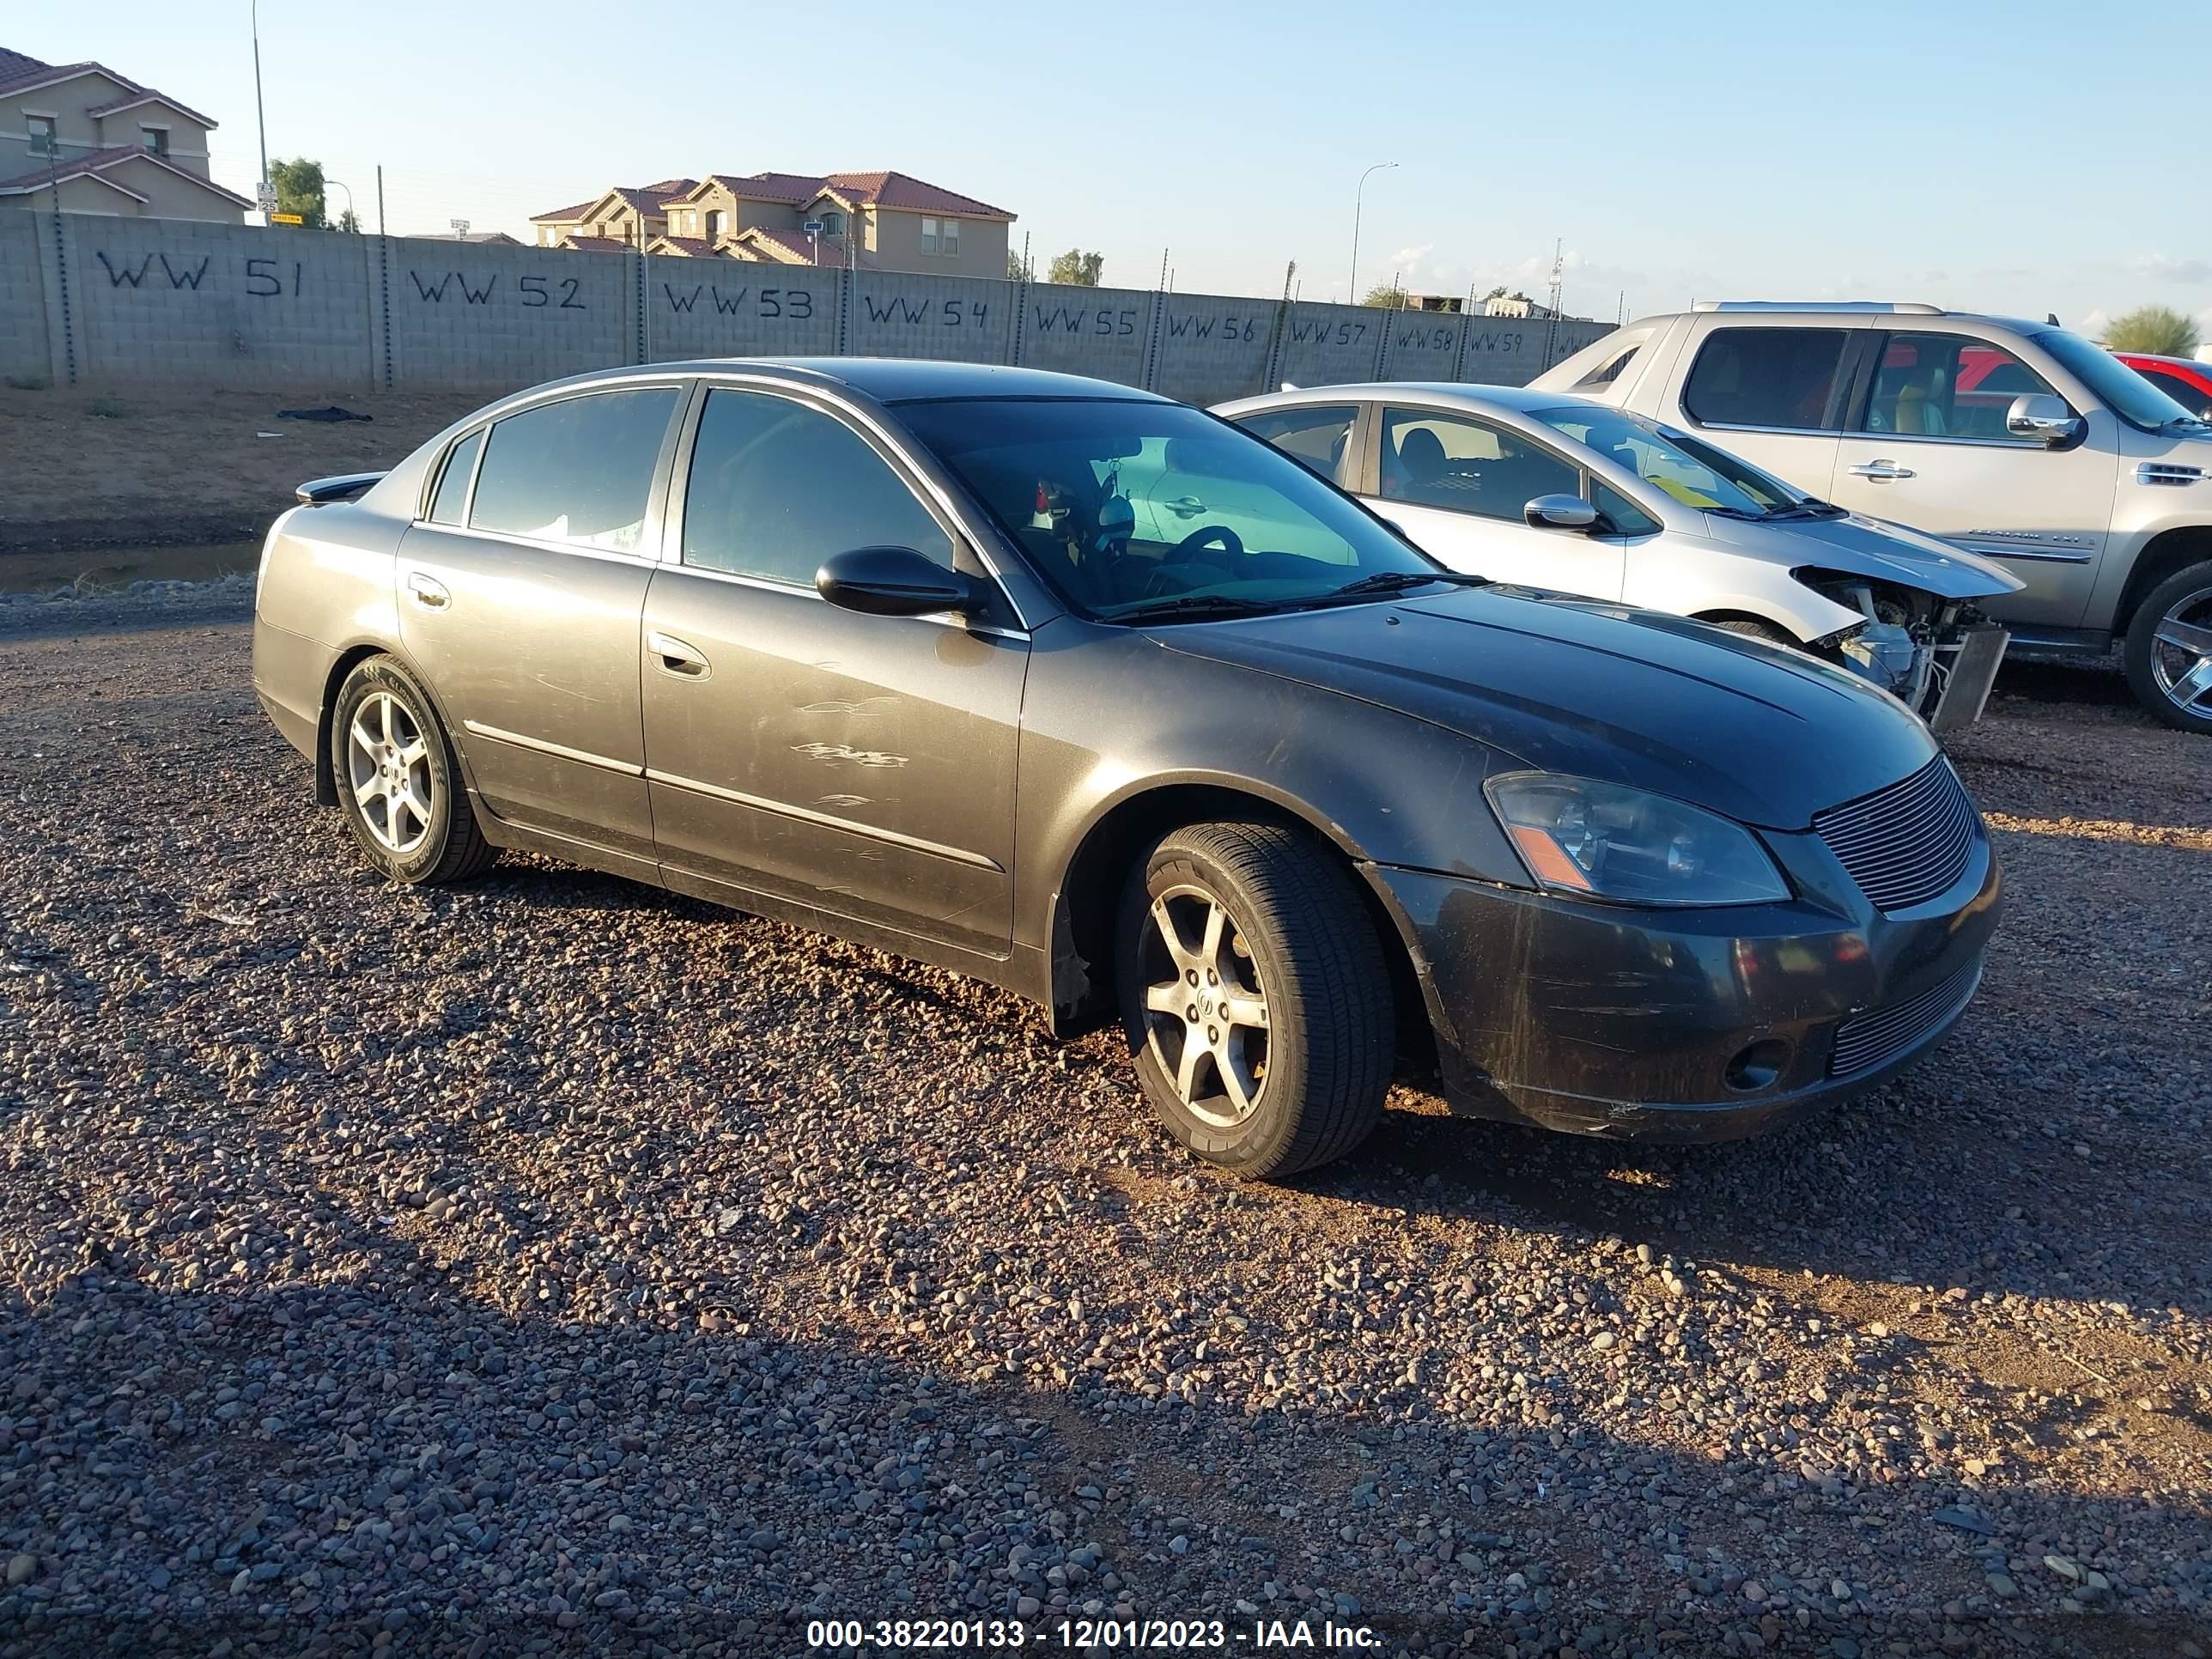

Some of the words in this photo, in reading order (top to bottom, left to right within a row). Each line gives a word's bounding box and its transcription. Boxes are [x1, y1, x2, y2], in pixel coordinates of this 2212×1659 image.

[261, 203, 276, 211] 25
[96, 251, 210, 291] WW
[246, 259, 301, 297] 51
[410, 269, 496, 305] WW
[520, 276, 586, 310] 52
[664, 283, 747, 316] WW
[760, 289, 813, 319] 53
[865, 296, 929, 325] WW
[945, 301, 988, 328] 54
[1036, 306, 1084, 333] WW
[1095, 311, 1136, 336] 55
[1170, 315, 1215, 339] WW
[1223, 319, 1254, 342] 56
[1293, 322, 1332, 344] WW
[1336, 324, 1366, 345] 57
[1397, 330, 1430, 349] WW
[1433, 330, 1453, 351] 58
[1471, 333, 1499, 351] WW
[1503, 333, 1522, 355] 59
